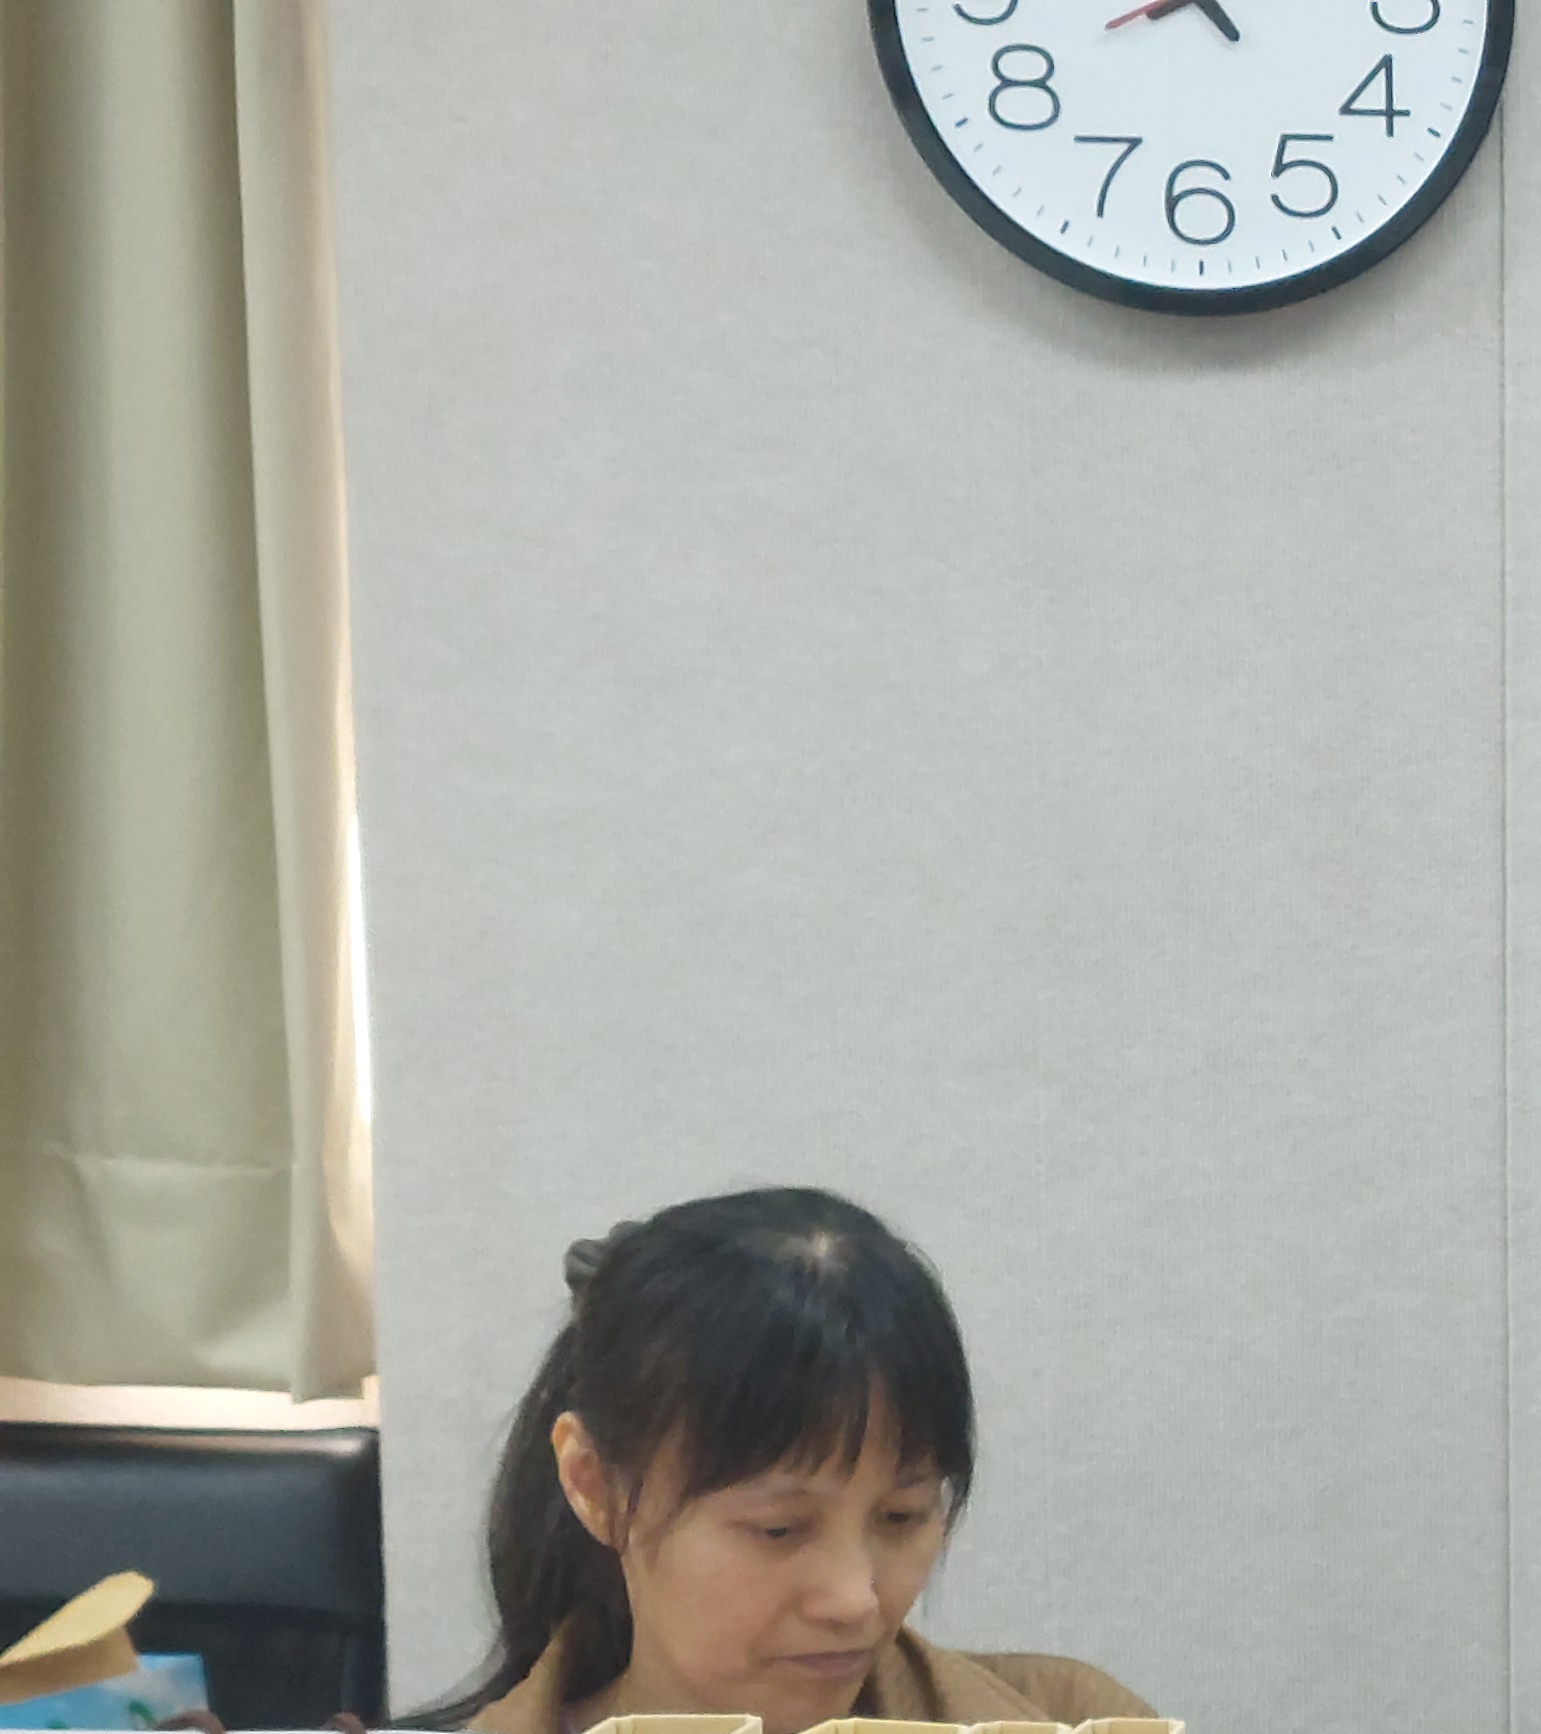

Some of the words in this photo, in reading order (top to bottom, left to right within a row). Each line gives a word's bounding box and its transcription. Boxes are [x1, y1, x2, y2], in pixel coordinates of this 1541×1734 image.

[988, 43, 1060, 131] 8
[1338, 54, 1411, 137] 4
[1074, 134, 1143, 218] 7
[1165, 159, 1236, 245] 6
[1270, 133, 1338, 218] 5
